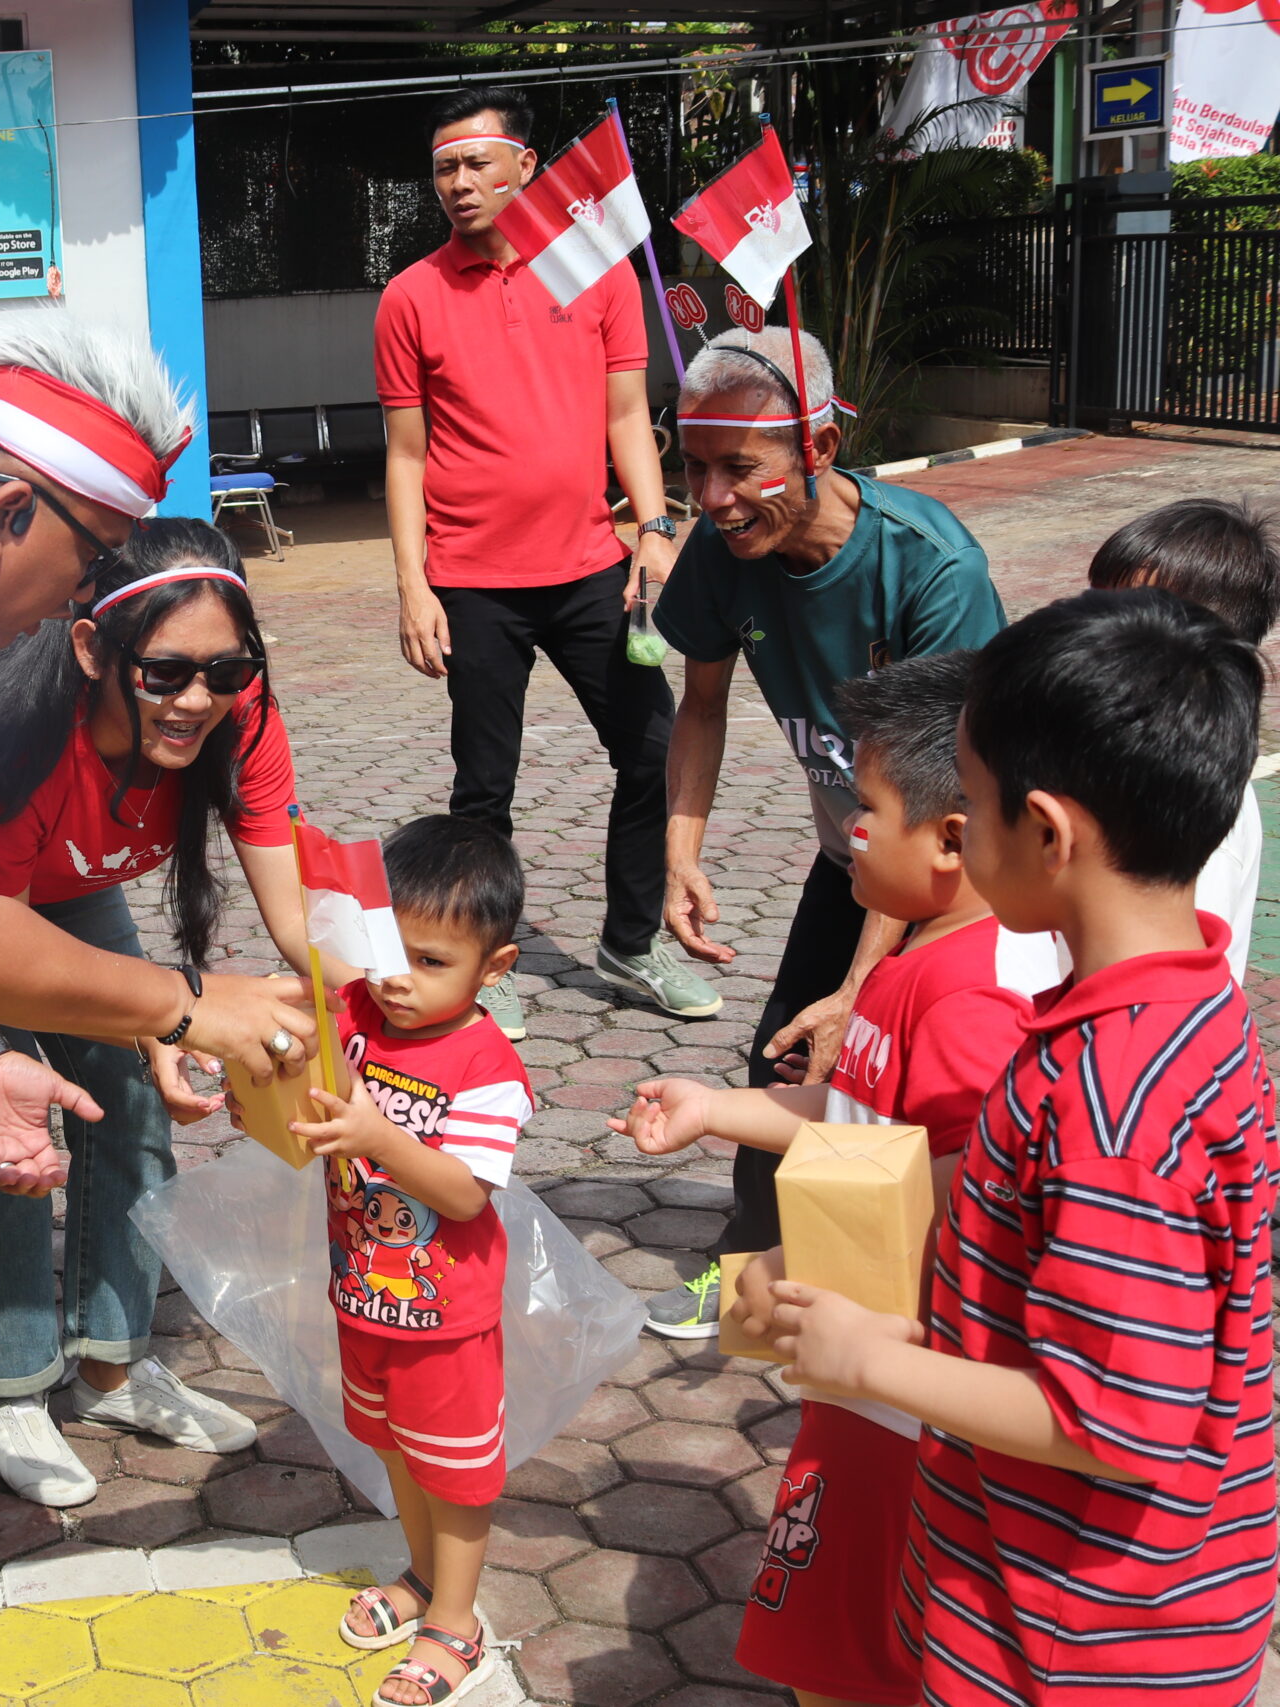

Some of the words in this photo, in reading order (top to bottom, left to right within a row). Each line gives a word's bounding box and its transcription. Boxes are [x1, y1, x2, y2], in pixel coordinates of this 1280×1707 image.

[1110, 112, 1145, 123] KELUAR
[1199, 103, 1273, 138] Berdaulat
[979, 134, 1017, 147] OPY
[10, 240, 36, 250] Store
[22, 266, 40, 277] Play
[665, 283, 707, 330] 80
[725, 284, 765, 333] 80
[365, 1063, 438, 1099] DIRGAHAYU
[336, 1280, 440, 1328] erdeka
